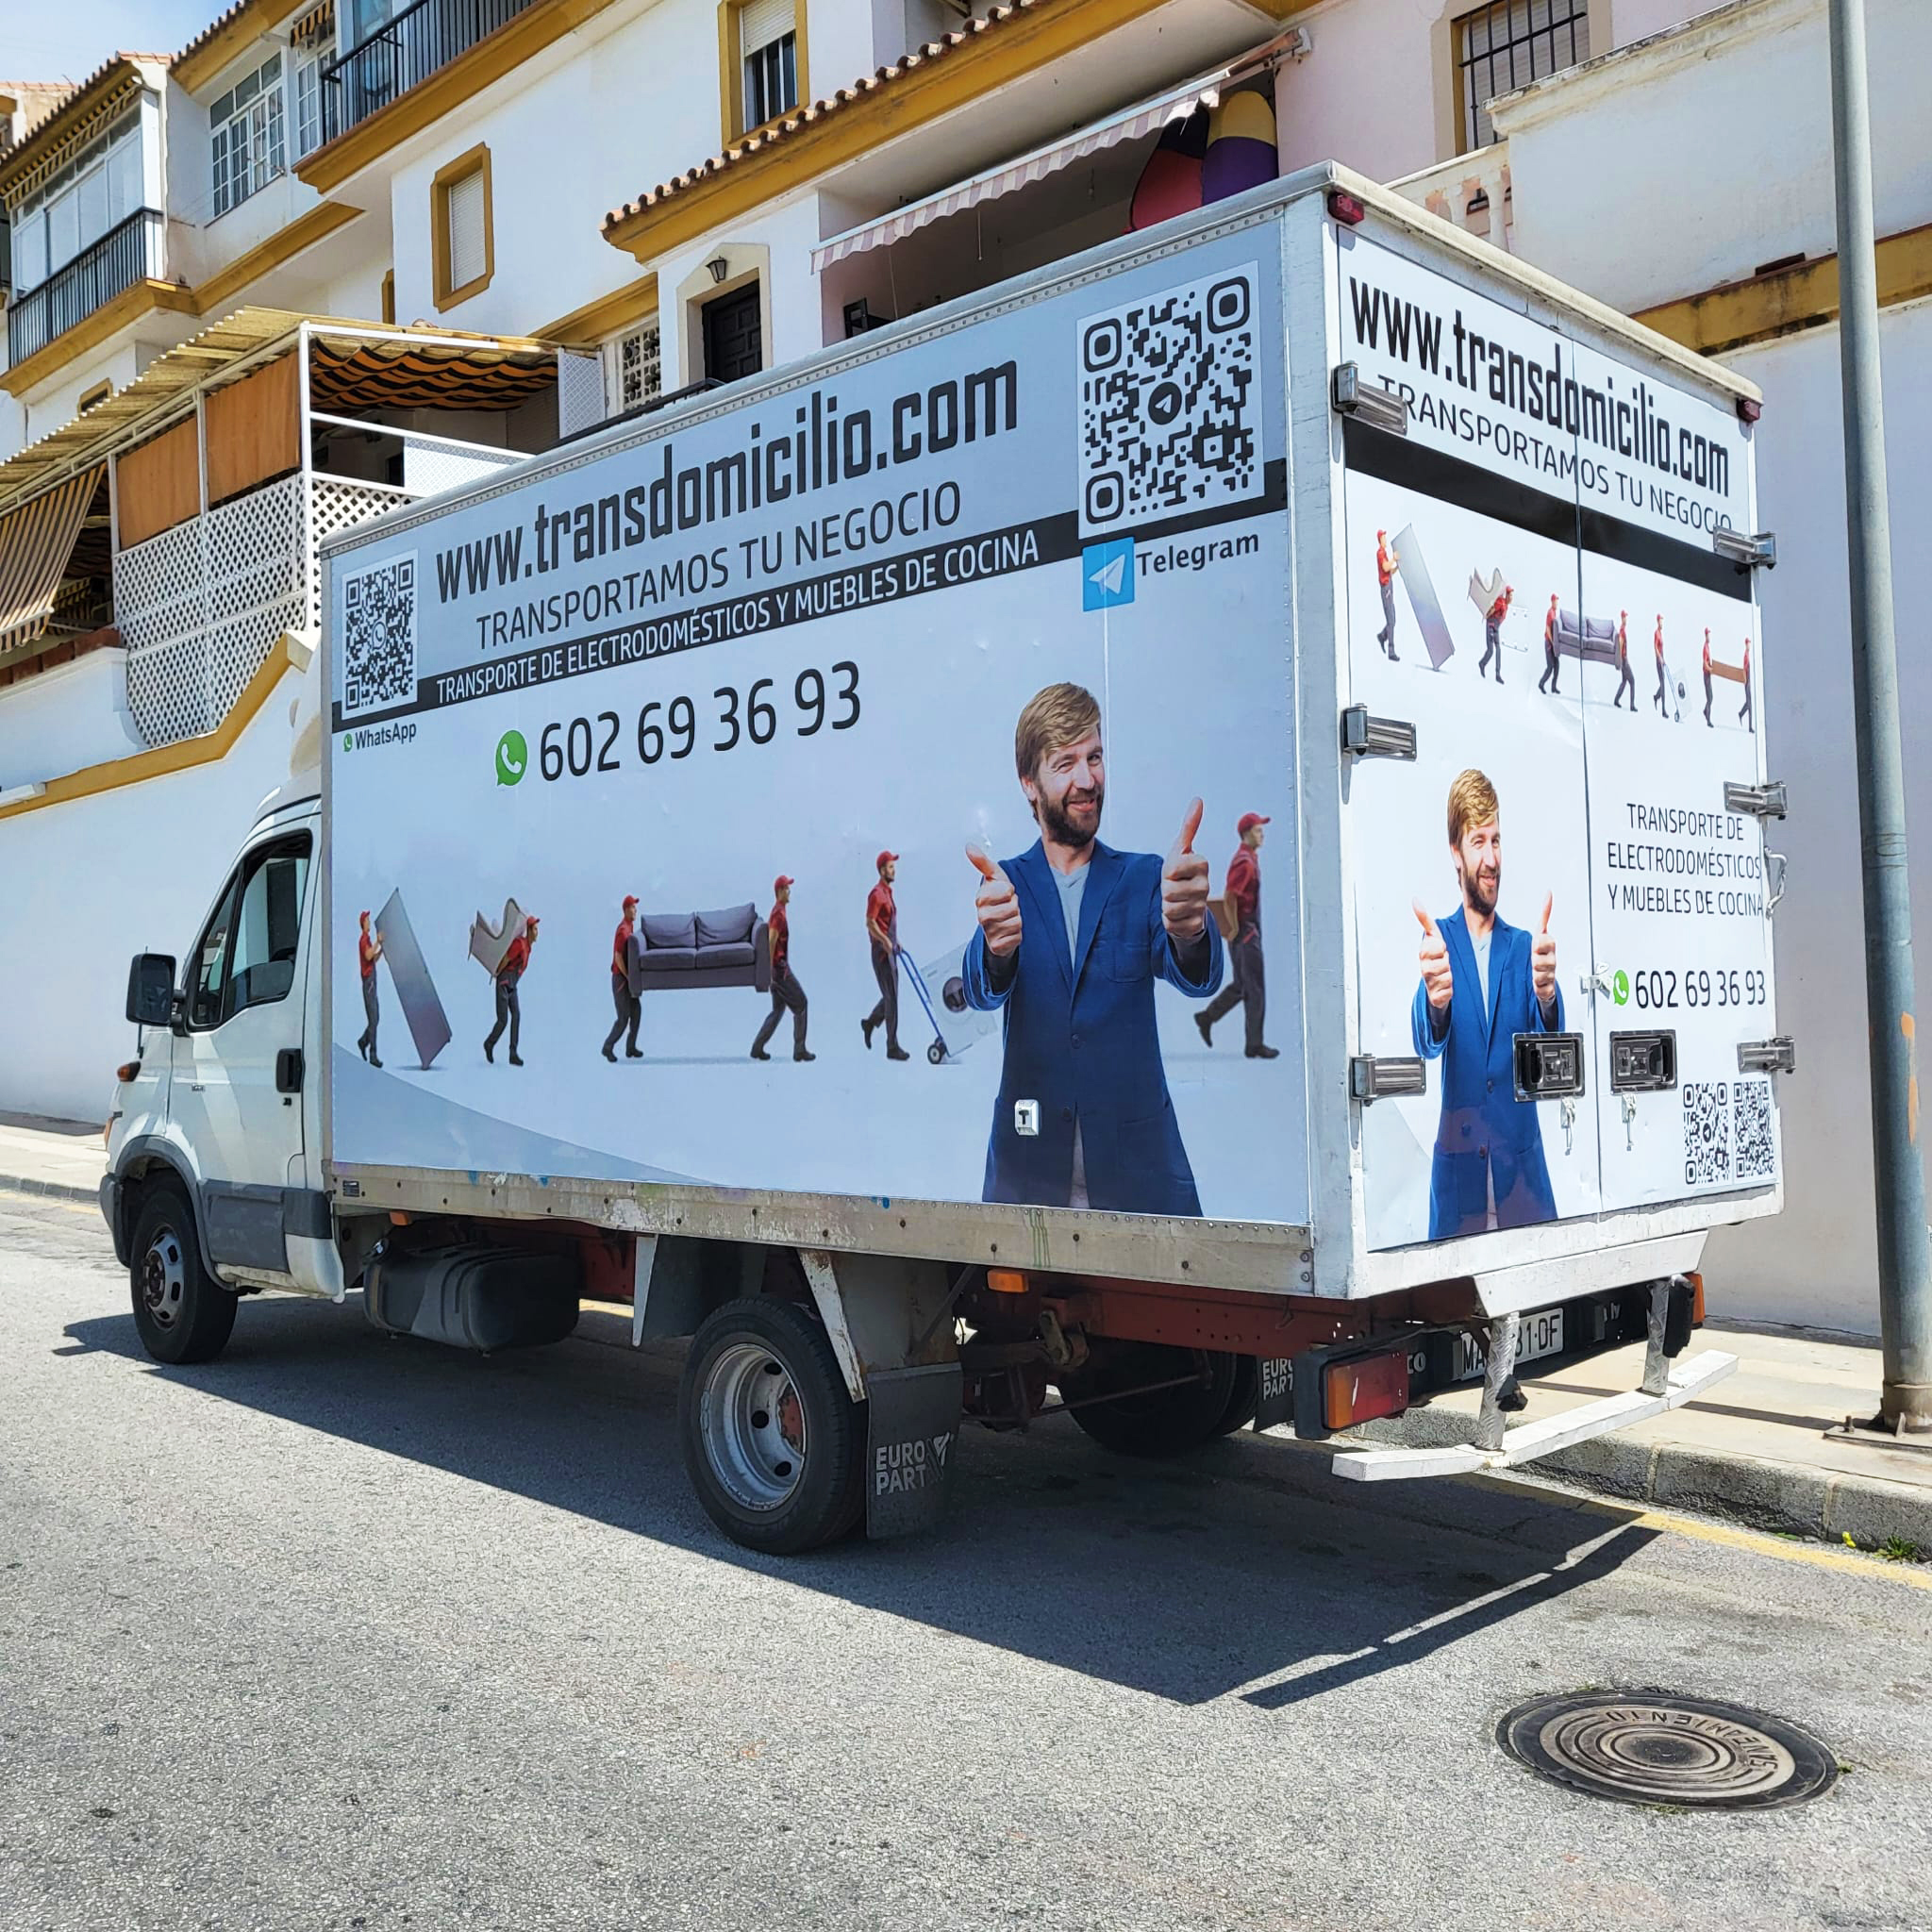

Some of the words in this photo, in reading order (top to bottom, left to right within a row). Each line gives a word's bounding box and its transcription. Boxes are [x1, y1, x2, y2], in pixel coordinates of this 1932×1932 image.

[1350, 275, 1729, 498] www.transdomicilio.com
[437, 359, 1018, 604] www.transdomicilio.com
[1615, 471, 1643, 508] TU
[476, 547, 729, 650] TRANSPORTAMOS
[740, 531, 782, 579] TU
[795, 481, 960, 566] NEGOCIO
[1136, 533, 1258, 576] Telegram
[437, 659, 537, 704] TRANSPORTE
[541, 653, 563, 679] DE
[567, 596, 771, 672] ELECTRODOMÉSTICOS
[775, 594, 788, 624] Y
[795, 564, 898, 620] MUEBLES
[906, 558, 936, 591] DE
[943, 529, 1039, 582] COCINA
[355, 723, 417, 750] WhatsApp
[541, 711, 620, 781] 602
[638, 696, 695, 764] 69
[713, 678, 776, 752] 36
[794, 660, 860, 737] 93
[1626, 803, 1723, 839] TRANSPORTE
[1727, 816, 1744, 841] DE
[1607, 841, 1761, 879] ELECTRODOMÉSTICOS
[1607, 884, 1618, 910] Y
[1623, 885, 1691, 914] MUEBLES
[1695, 890, 1714, 914] DE
[1718, 891, 1763, 916] COCINA
[1635, 970, 1679, 1009] 602
[1685, 970, 1711, 1008] 69
[1716, 970, 1740, 1007] 36
[1745, 970, 1766, 1006] 93
[876, 1440, 925, 1471] EURO
[876, 1464, 926, 1496] PART
